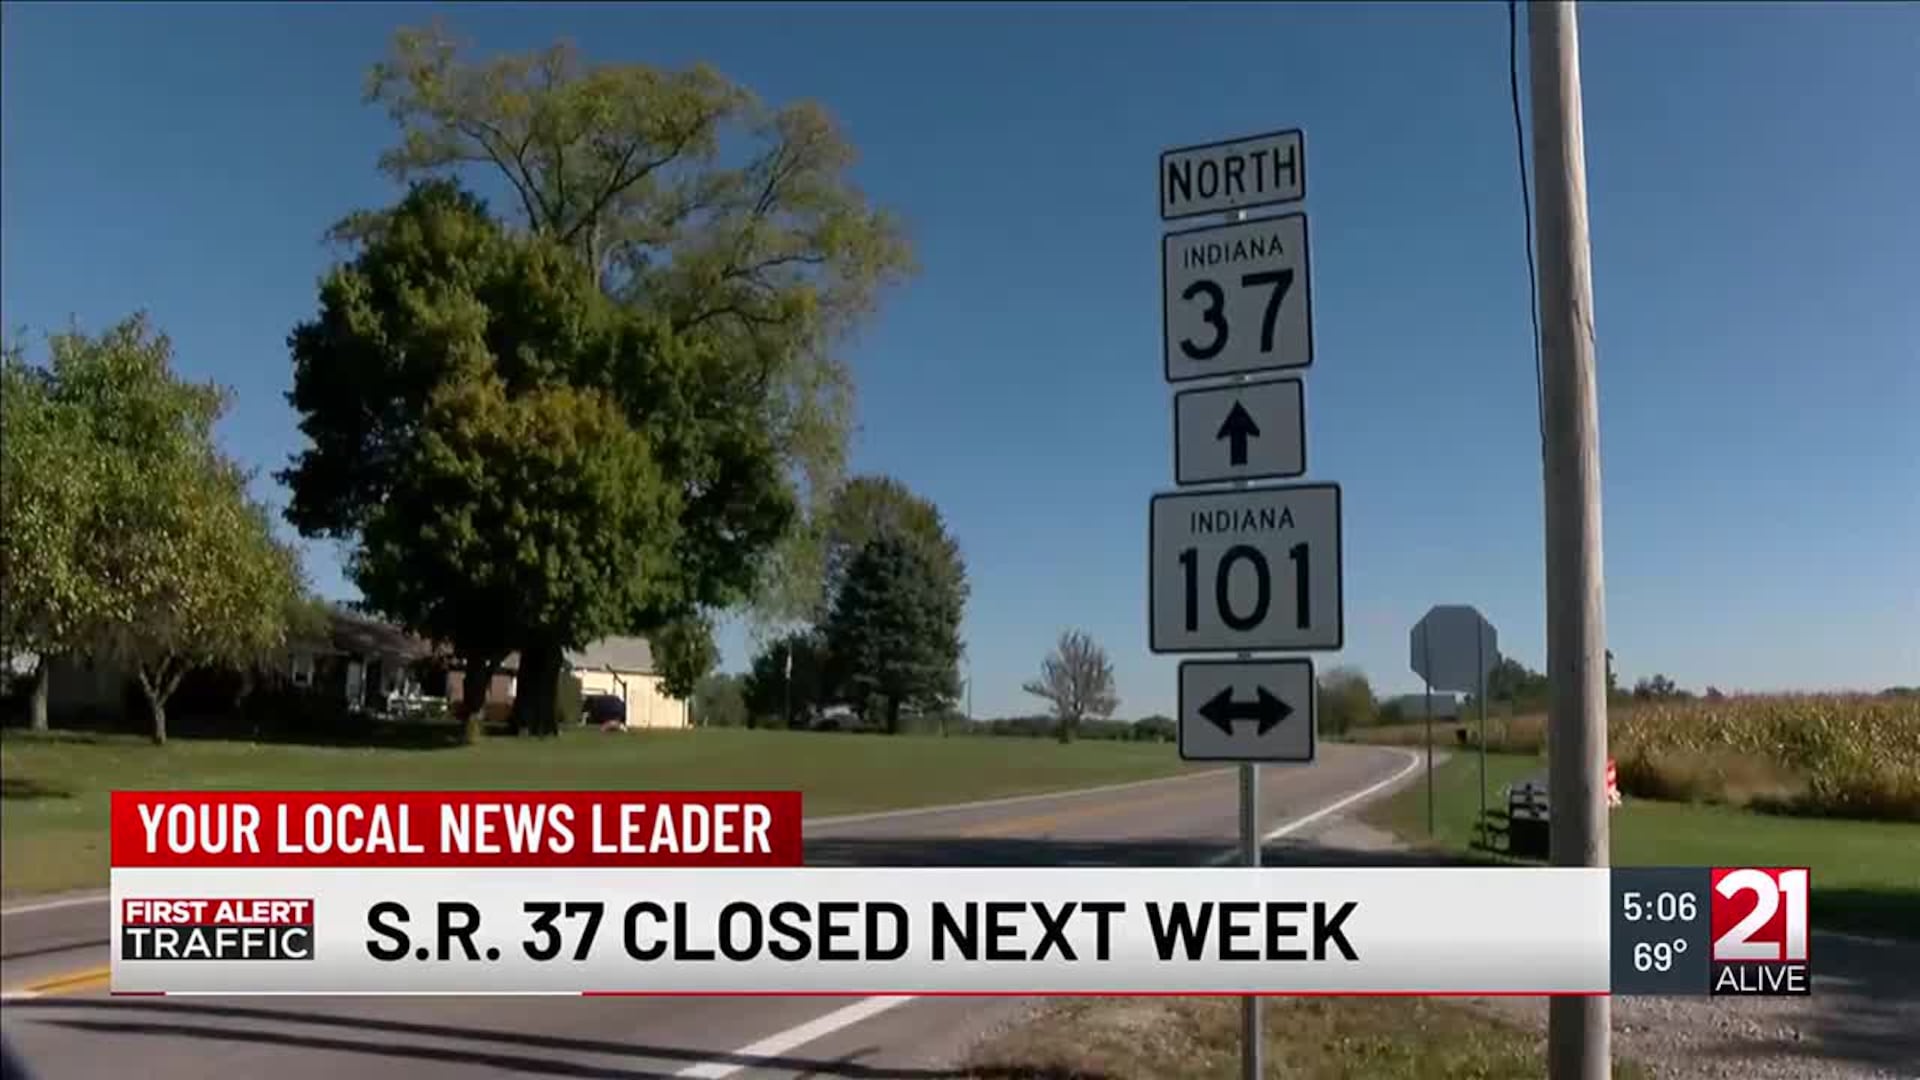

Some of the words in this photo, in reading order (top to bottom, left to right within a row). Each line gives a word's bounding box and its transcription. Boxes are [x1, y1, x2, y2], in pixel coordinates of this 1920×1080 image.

[1168, 144, 1296, 204] NORTH
[1184, 233, 1283, 268] INDIANA
[1179, 268, 1294, 360] 37
[1191, 505, 1295, 533] INDIANA
[1178, 541, 1311, 632] 101
